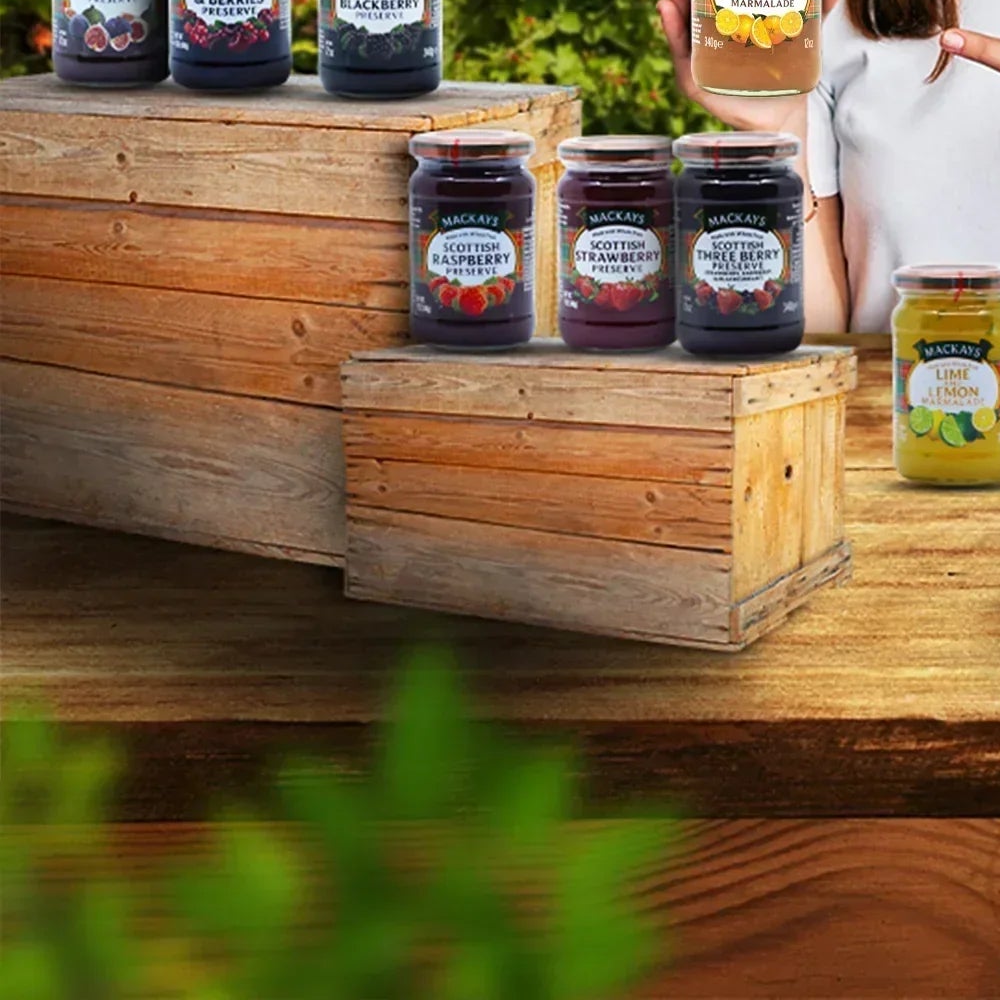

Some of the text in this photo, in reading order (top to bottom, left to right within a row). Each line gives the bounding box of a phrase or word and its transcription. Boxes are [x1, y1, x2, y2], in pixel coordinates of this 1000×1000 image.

[731, 0, 795, 8] MARMALADE
[202, 6, 256, 17] PRESERVE
[441, 213, 499, 227] MACKAYS
[589, 211, 645, 224] MACKAYS
[708, 212, 766, 227] MACKAYS
[443, 242, 501, 253] SCOTTISH
[590, 240, 645, 250] SCOTTISH
[712, 240, 764, 251] SCOTTISH
[432, 253, 510, 266] RASPBERRY
[575, 250, 660, 263] STRAWBERRY
[696, 249, 780, 262] THREE BERRY
[446, 267, 497, 276] PRESERVE
[592, 264, 642, 273] PRESERVE
[712, 261, 763, 271] PRESERVE
[924, 343, 981, 358] MACKAYS
[936, 368, 970, 380] LIME
[928, 386, 979, 398] LEMON
